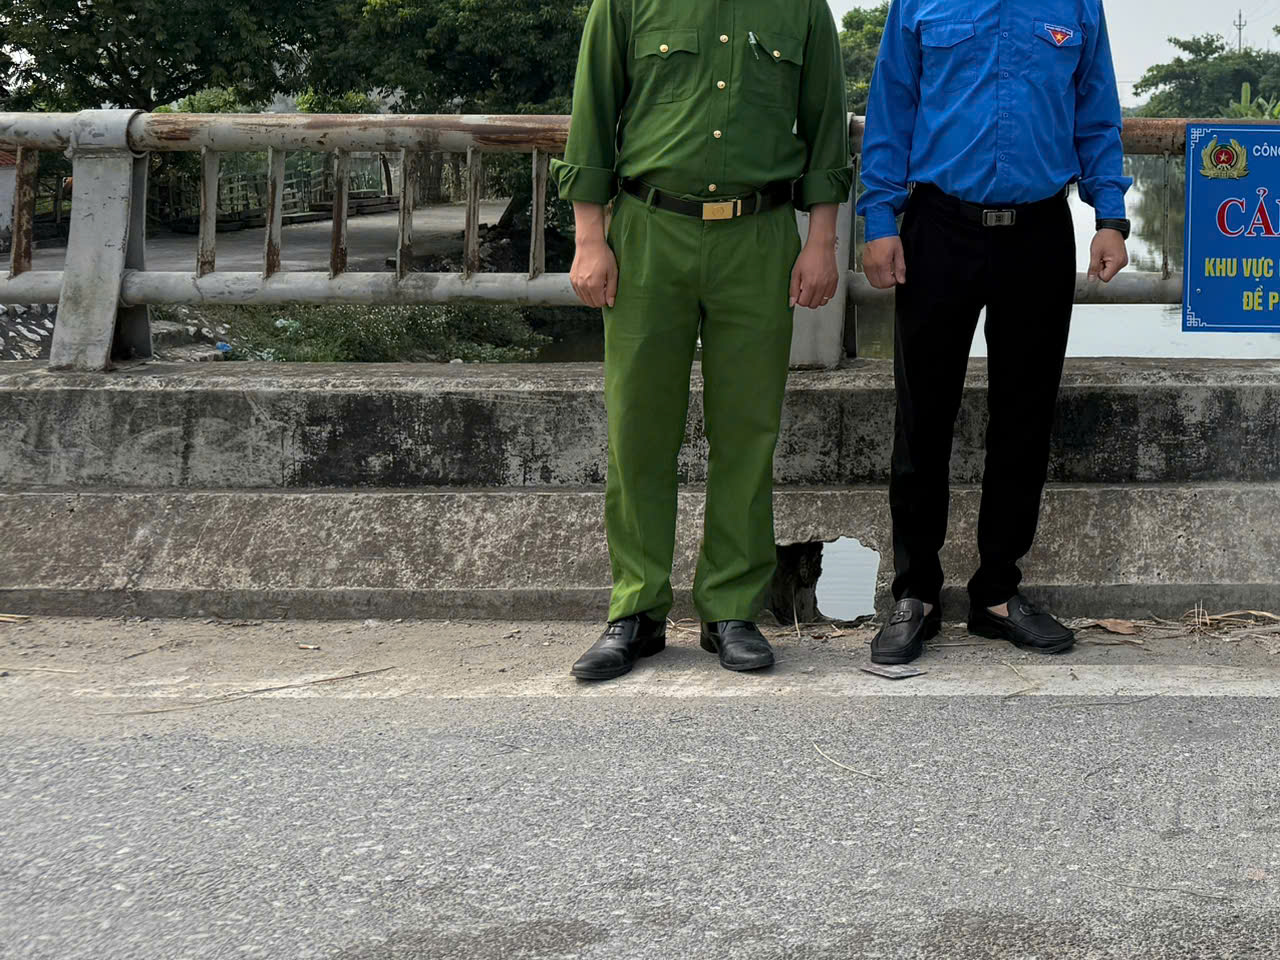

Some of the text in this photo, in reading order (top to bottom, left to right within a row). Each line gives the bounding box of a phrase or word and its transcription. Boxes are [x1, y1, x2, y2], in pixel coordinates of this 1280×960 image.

[1204, 257, 1238, 277] KHU
[1242, 256, 1274, 282] VỰC
[1242, 285, 1264, 311] ĐỀ
